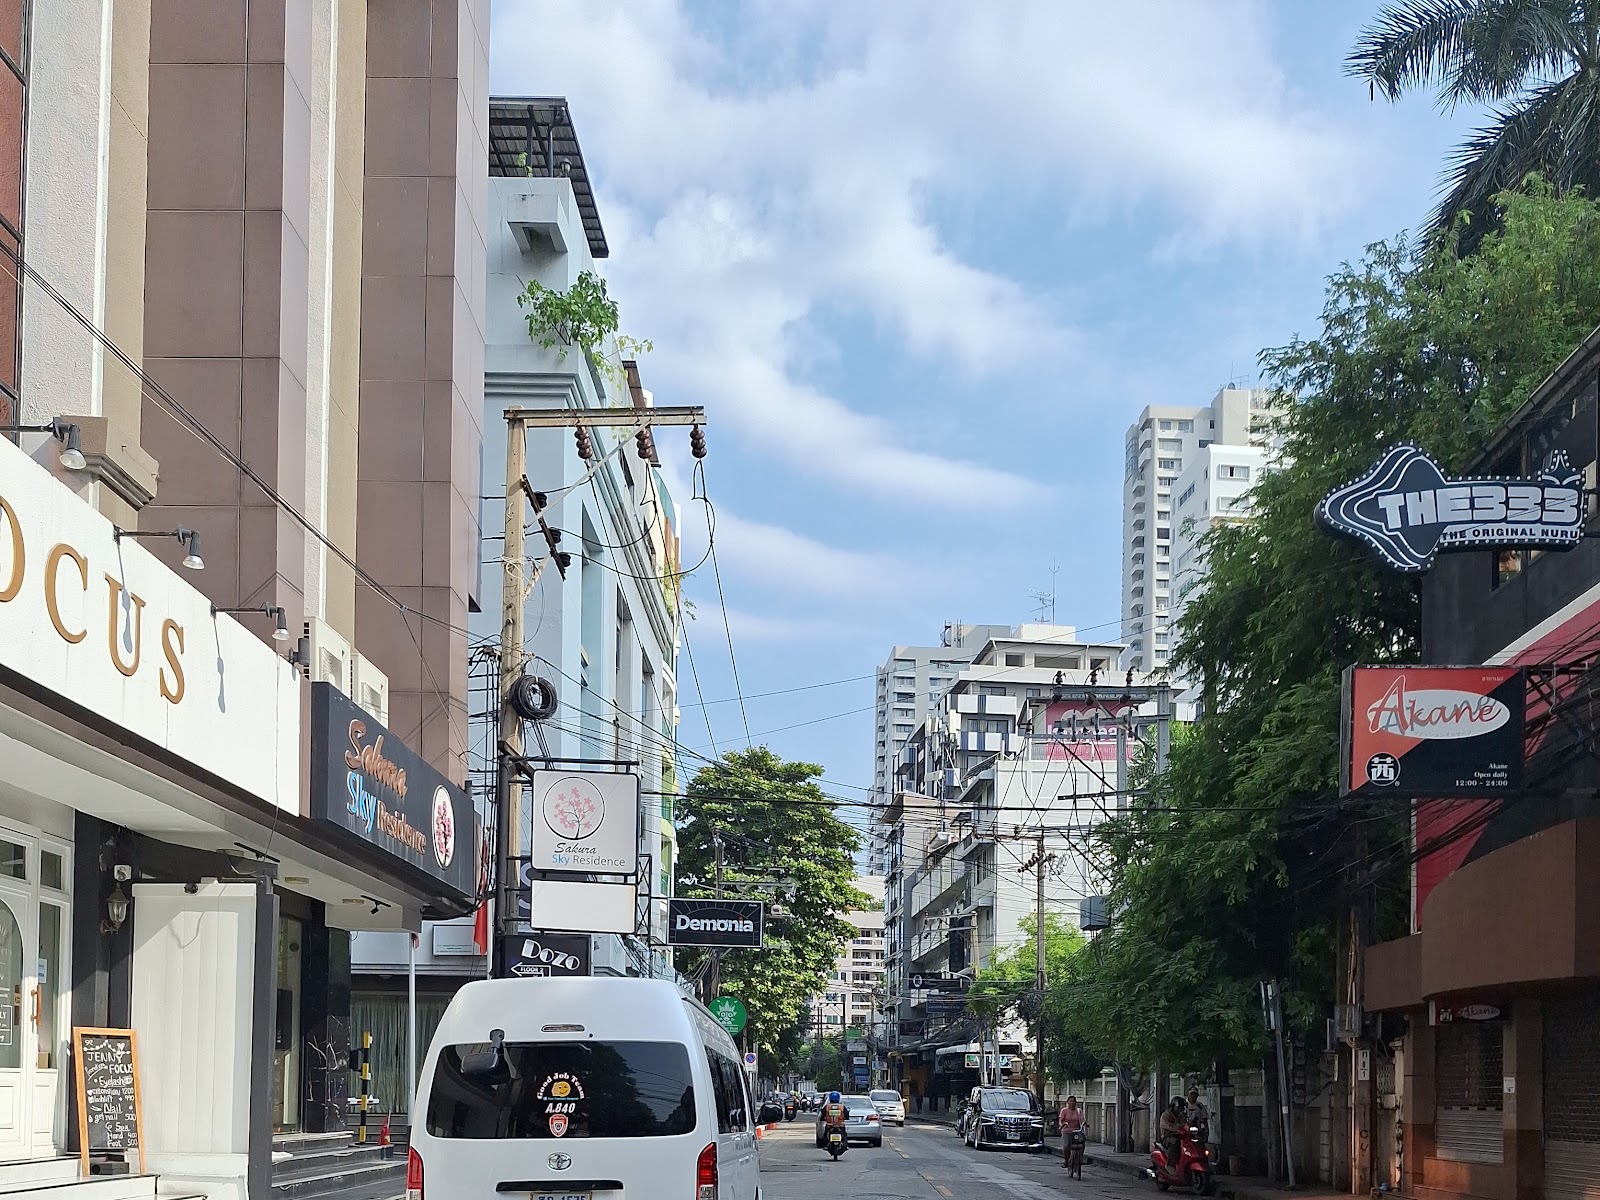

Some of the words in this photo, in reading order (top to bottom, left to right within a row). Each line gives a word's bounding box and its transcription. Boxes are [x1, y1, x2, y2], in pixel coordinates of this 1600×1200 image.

[1442, 530, 1467, 541] THE
[1472, 528, 1536, 538] ORIGINAL
[1541, 528, 1579, 539] NURU
[1368, 674, 1503, 735] Akane
[1492, 771, 1508, 779] daily
[347, 771, 377, 834] Sky
[376, 799, 427, 855] Residence
[554, 842, 598, 855] Sakura
[551, 854, 571, 866] Sky
[572, 855, 626, 867] Residence
[675, 914, 754, 932] Demonia
[86, 1051, 123, 1064] JENNY
[109, 1063, 133, 1074] FOCUS
[536, 1075, 553, 1100] Good
[552, 1072, 570, 1080] Job
[570, 1075, 585, 1100] Team
[103, 1103, 122, 1113] Nail
[545, 1102, 576, 1114] A.840
[125, 1113, 136, 1121] 500
[115, 1122, 129, 1131] Spa
